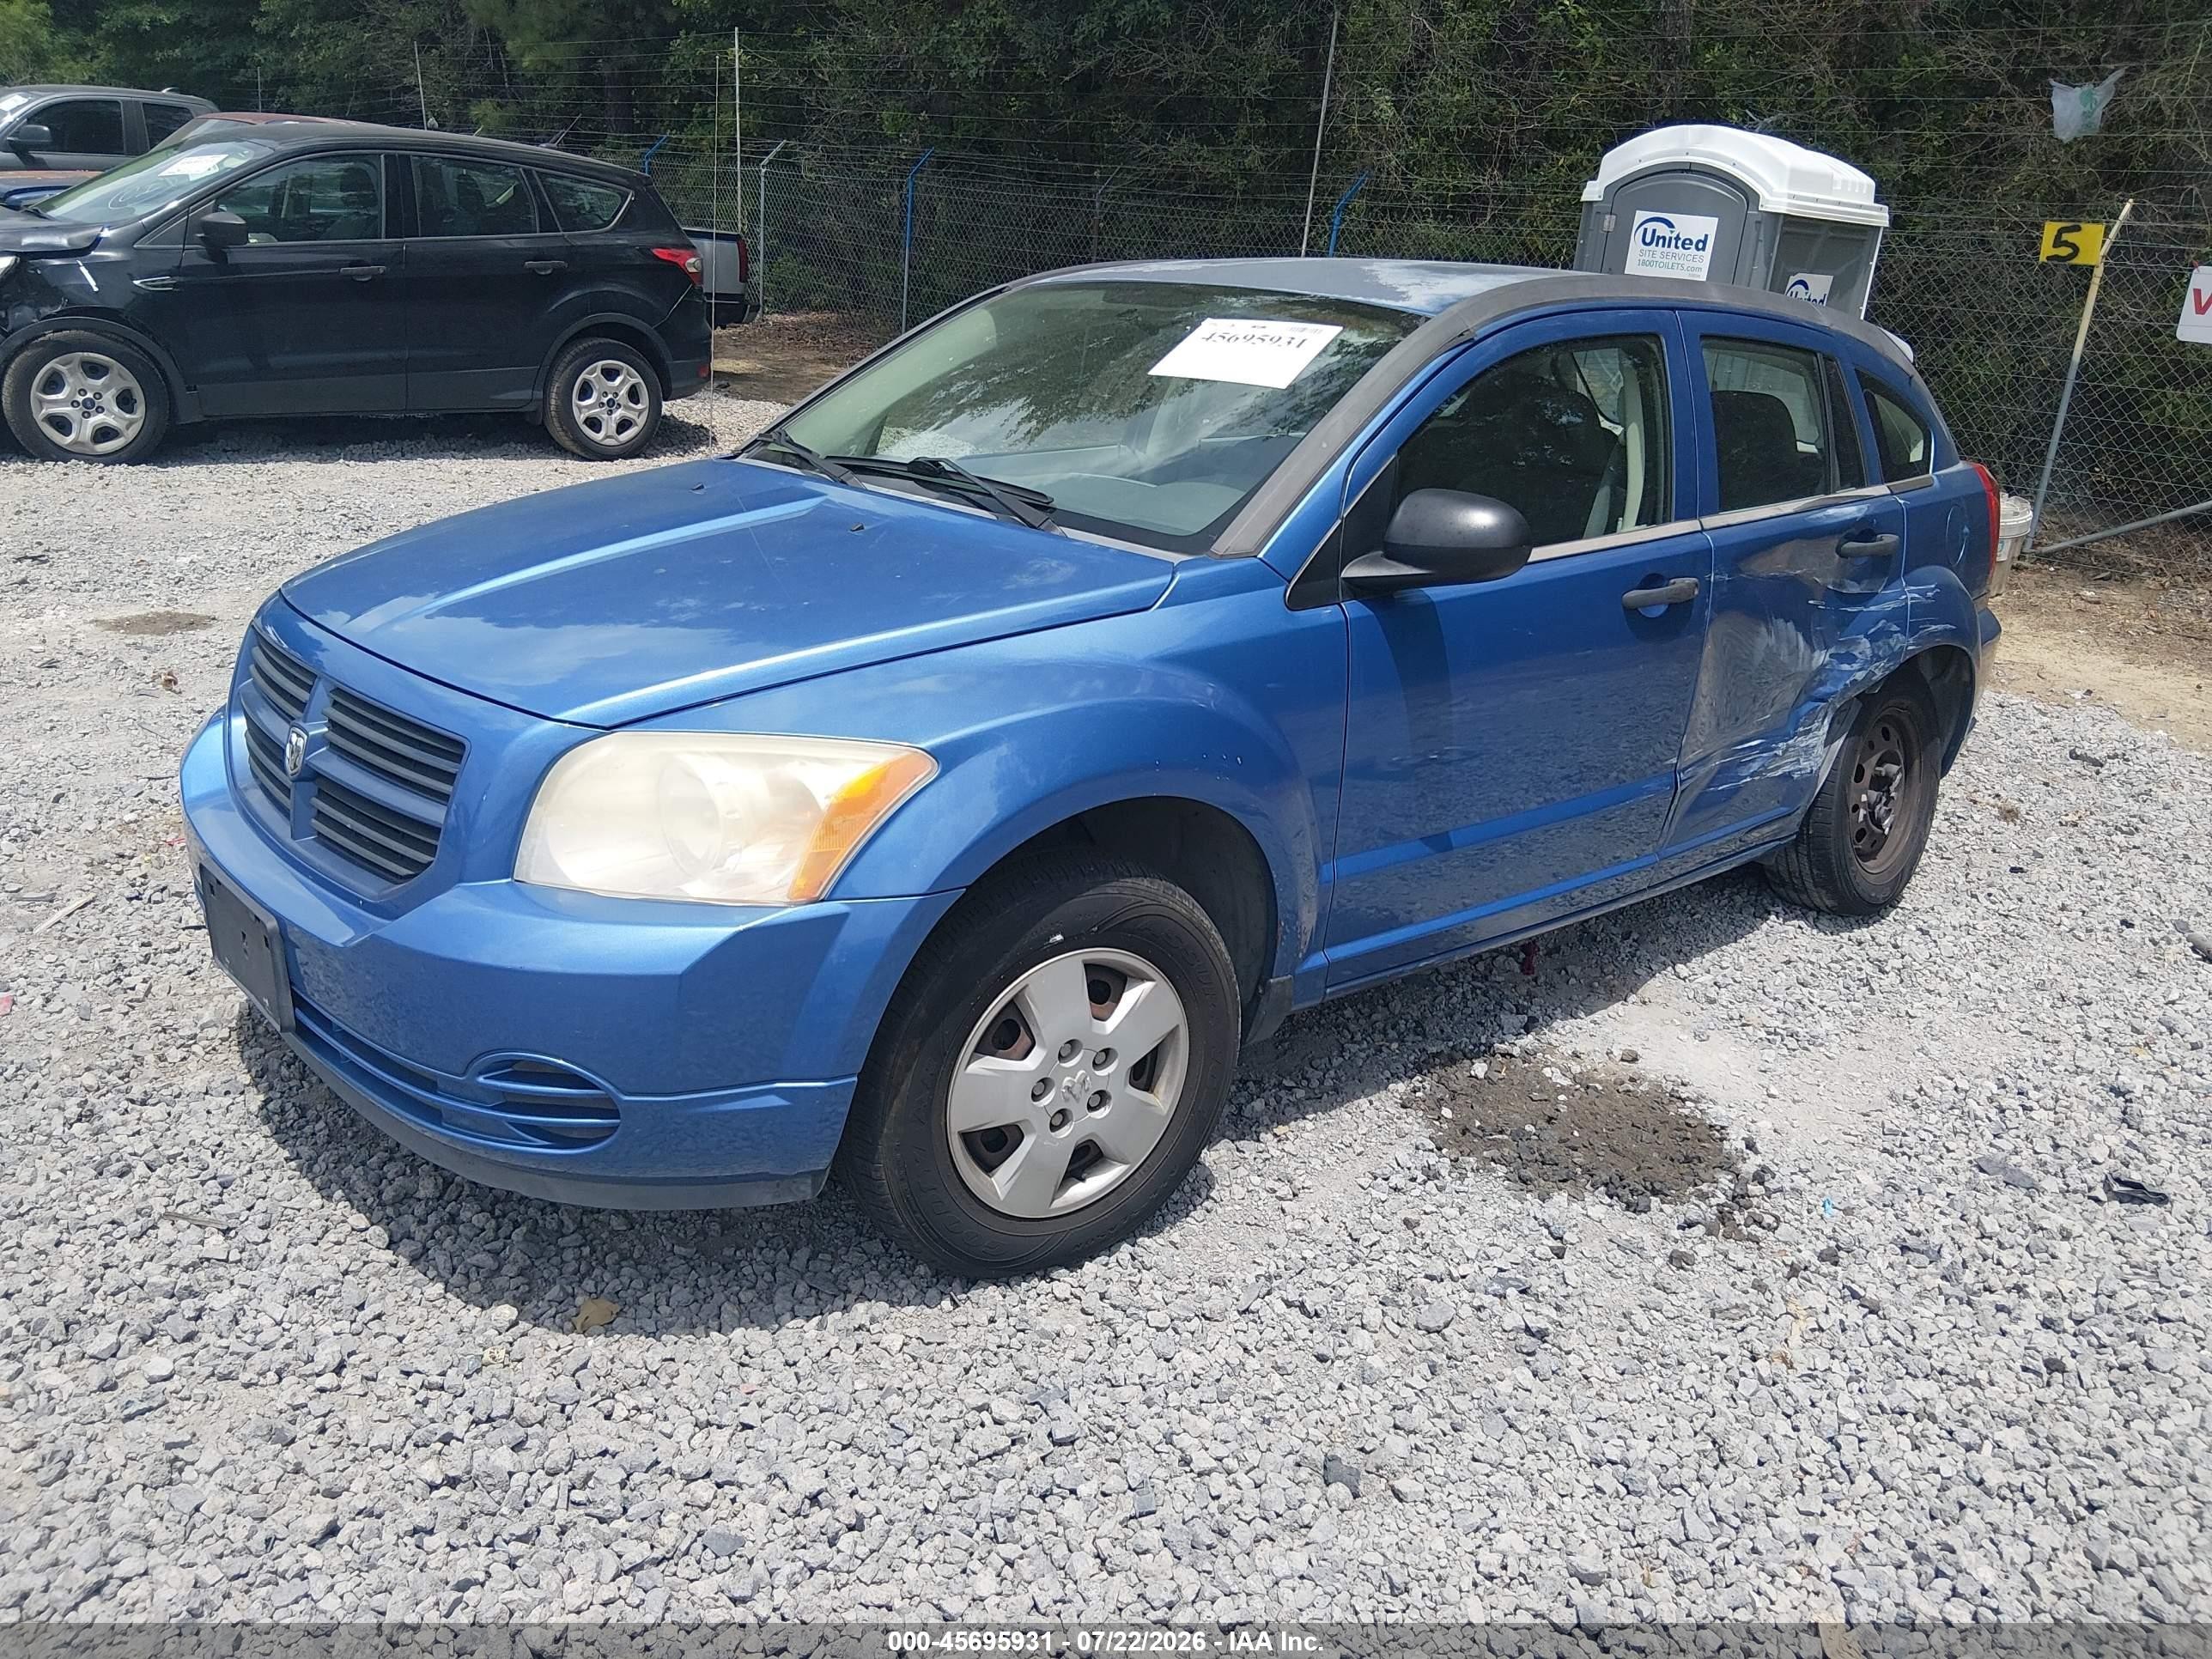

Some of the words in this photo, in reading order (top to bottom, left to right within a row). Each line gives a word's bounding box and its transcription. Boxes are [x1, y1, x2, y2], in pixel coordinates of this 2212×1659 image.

[1641, 227, 1709, 252] United
[2045, 224, 2082, 263] 5
[1637, 259, 1703, 272] 1800TOILETS.com
[1638, 249, 1657, 258] SITE
[1659, 252, 1705, 264] SERVICES
